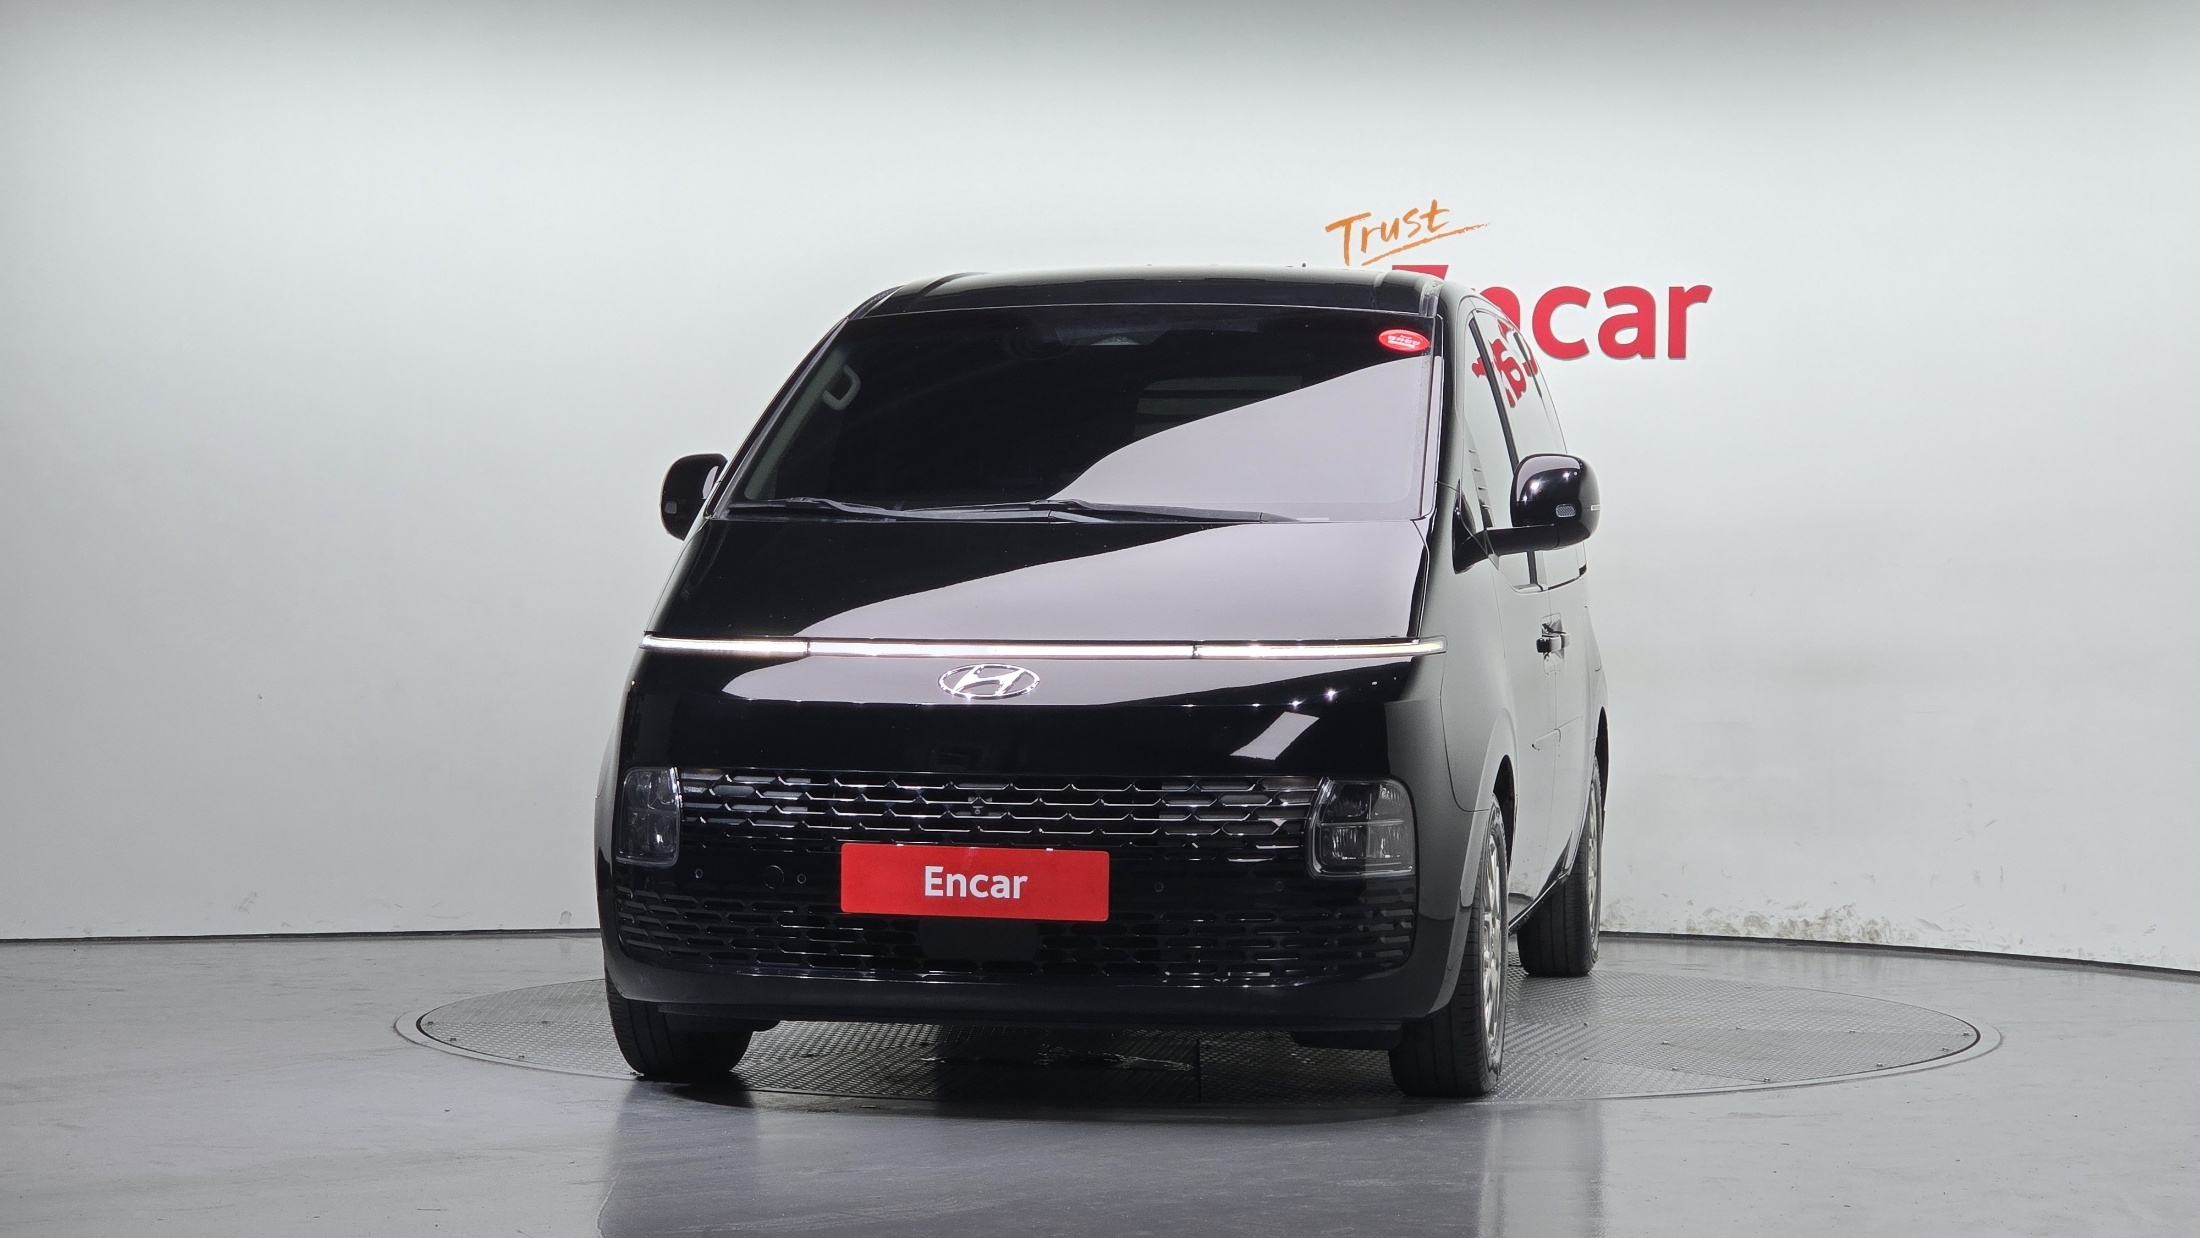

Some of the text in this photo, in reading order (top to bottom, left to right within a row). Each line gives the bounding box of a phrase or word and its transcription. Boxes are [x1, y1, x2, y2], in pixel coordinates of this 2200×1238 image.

[1326, 199, 1451, 266] Trust
[1392, 264, 1713, 360] car
[923, 865, 1029, 900] Encar
